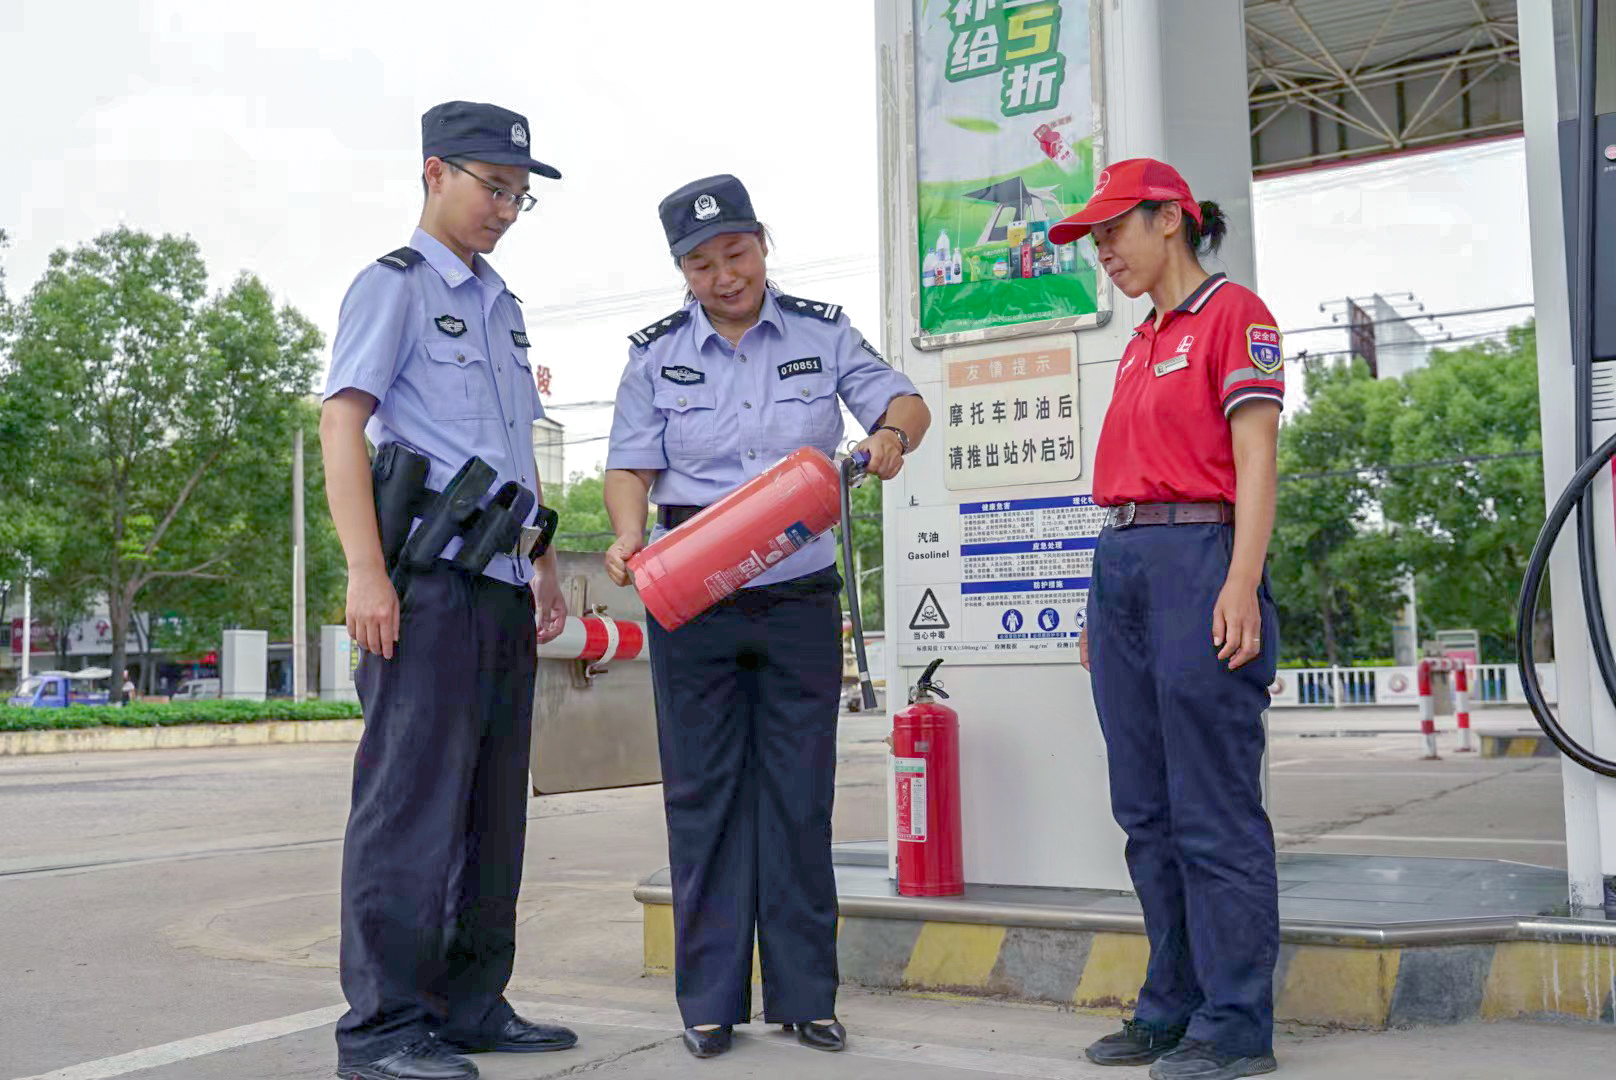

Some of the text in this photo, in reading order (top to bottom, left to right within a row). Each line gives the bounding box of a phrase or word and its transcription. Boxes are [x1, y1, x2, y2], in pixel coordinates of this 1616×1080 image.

[781, 360, 819, 375] 070851
[964, 356, 1051, 380] 友情提示
[949, 394, 1073, 427] 摩托车加油后
[948, 435, 1075, 470] 请推出站外启动
[981, 503, 1011, 511] 健康危害
[918, 532, 939, 543] 汽油
[1032, 541, 1063, 551] 应急处理
[1033, 580, 1064, 590] 防护措施
[913, 631, 946, 641] 当心中毒
